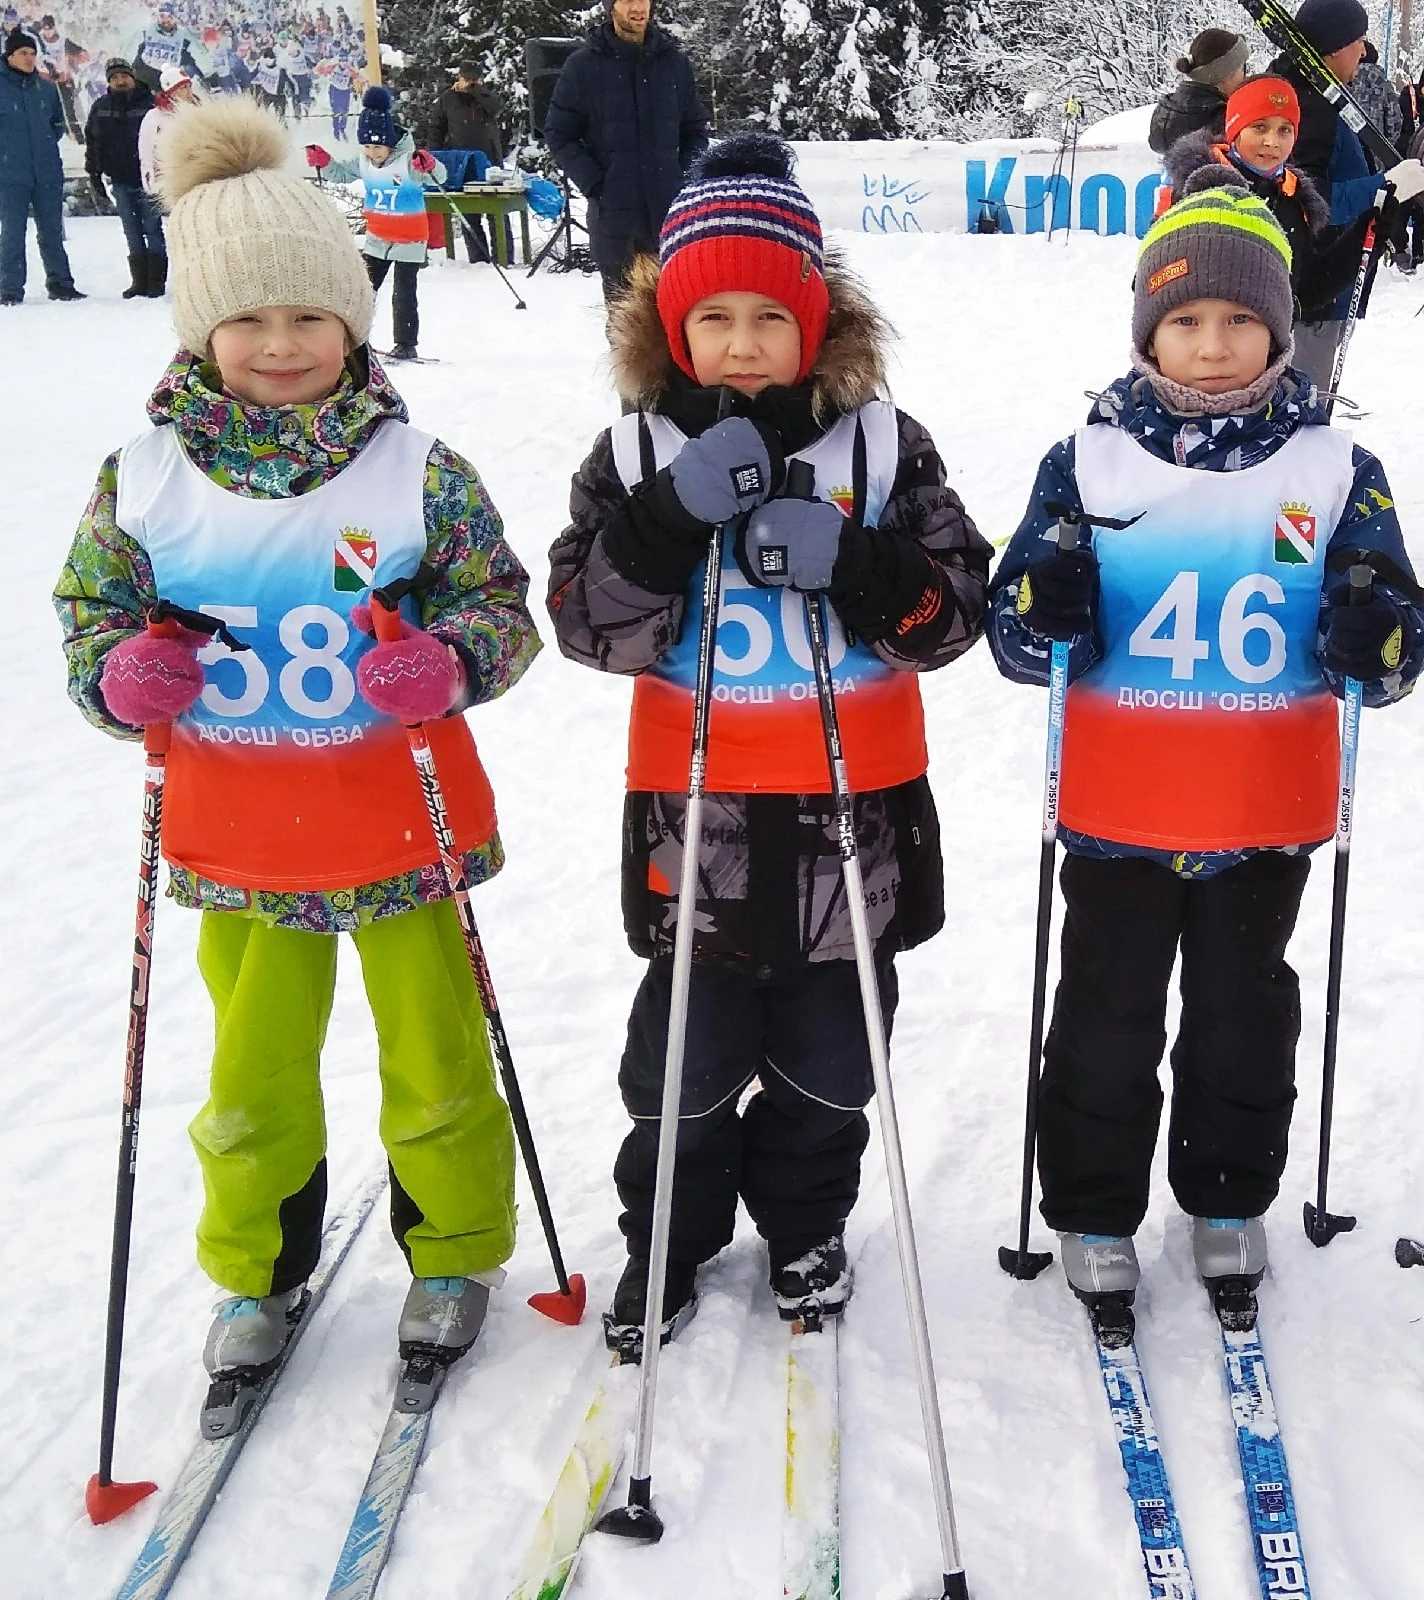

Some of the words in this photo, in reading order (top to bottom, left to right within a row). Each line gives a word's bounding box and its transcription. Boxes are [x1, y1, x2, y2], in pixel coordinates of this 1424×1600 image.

[371, 188, 399, 211] 27
[1128, 571, 1287, 684] 46
[197, 604, 356, 719] 58
[1117, 686, 1203, 711] ДЮСШ
[1211, 690, 1296, 712] "ОБВА"
[282, 721, 372, 748] "ОБВА"
[1049, 770, 1059, 782] JR
[1047, 783, 1059, 821] CLASSIC
[1342, 787, 1352, 799] JR
[1339, 800, 1351, 833] CLASSIC
